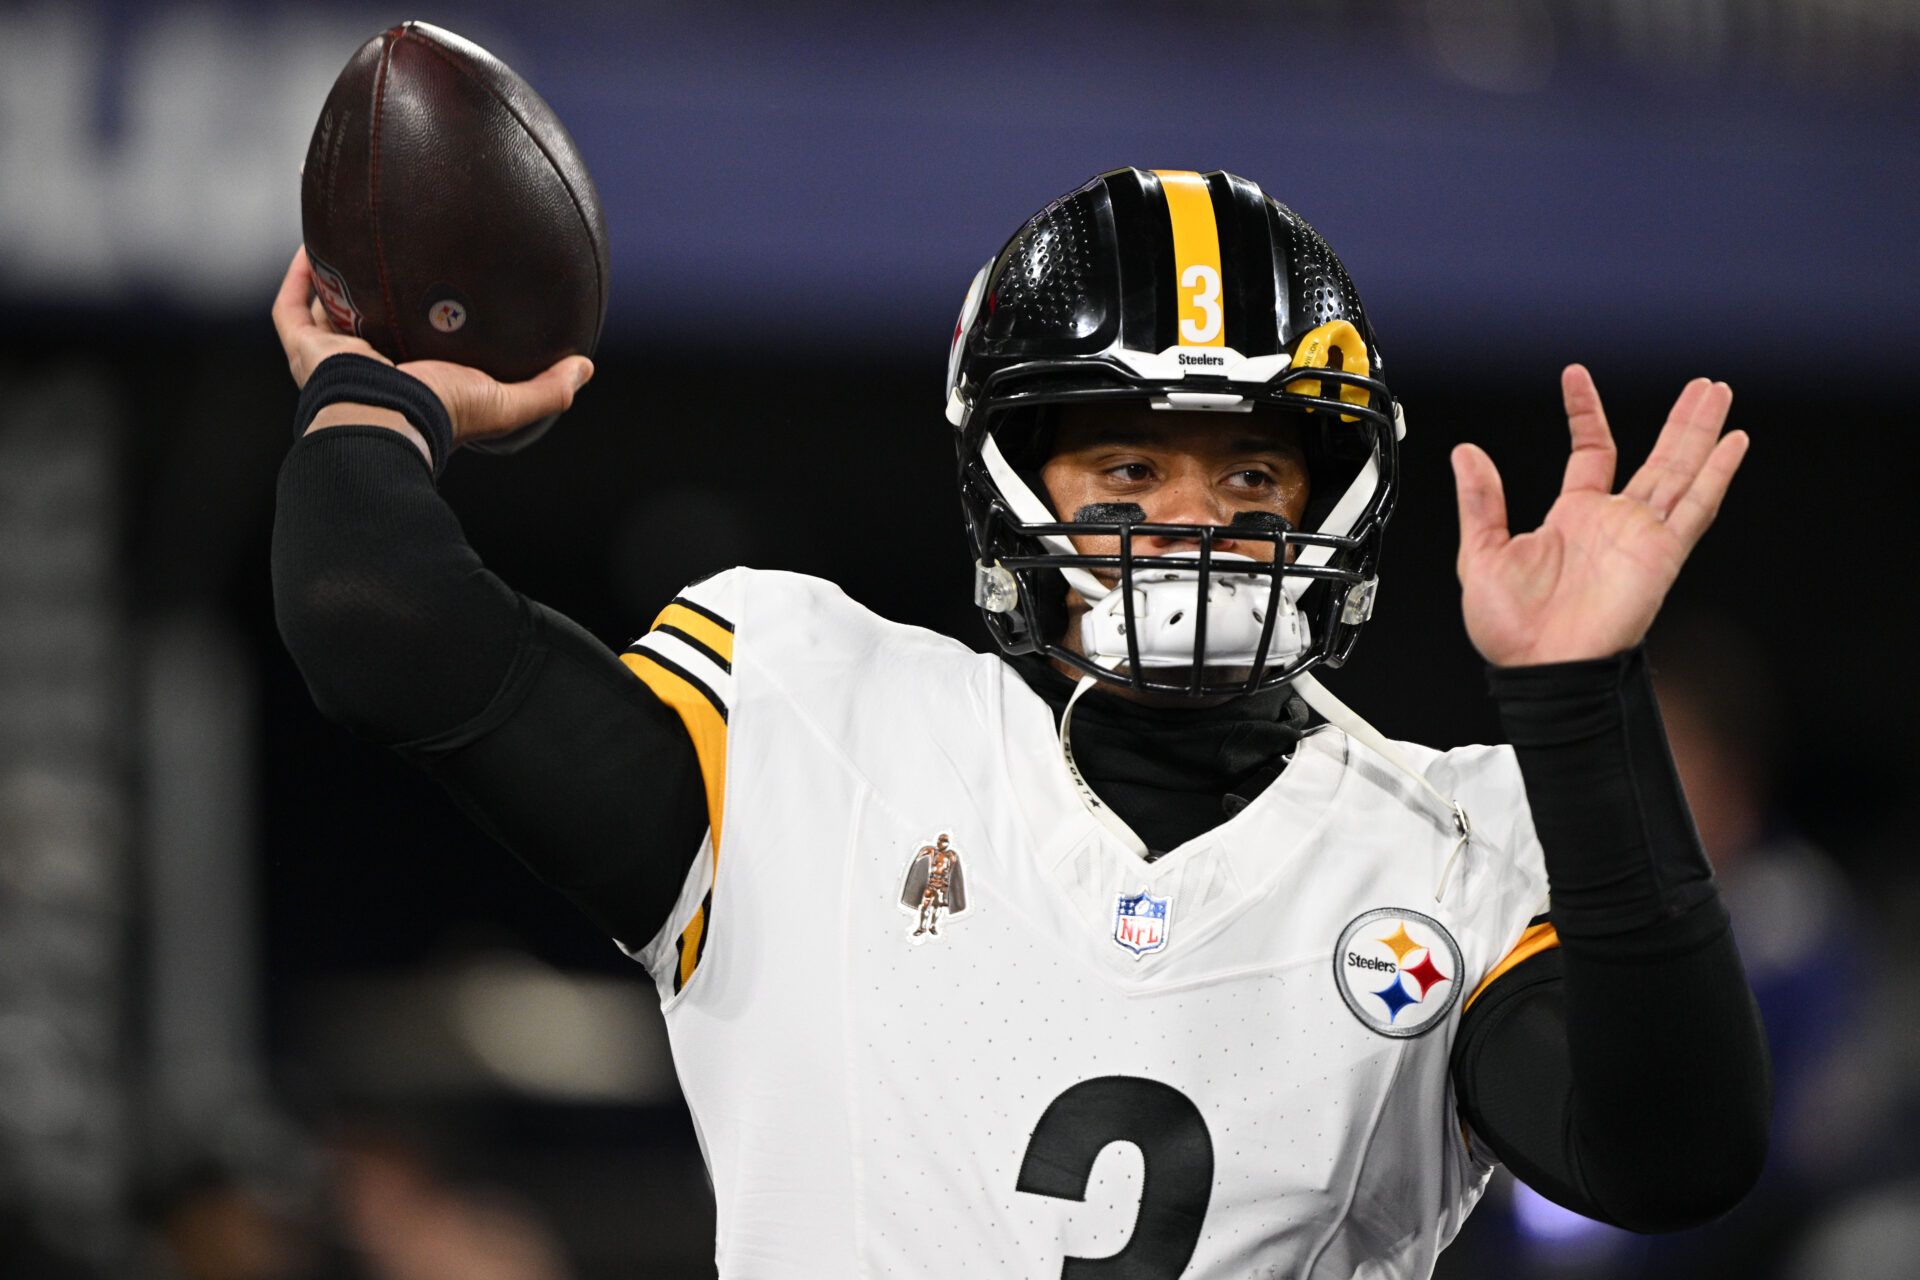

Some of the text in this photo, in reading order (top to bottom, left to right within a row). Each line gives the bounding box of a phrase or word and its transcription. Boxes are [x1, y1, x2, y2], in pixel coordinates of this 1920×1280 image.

[1181, 264, 1222, 343] 3
[1178, 353, 1224, 366] Steelers
[1120, 917, 1159, 946] NFL
[1347, 951, 1397, 974] Steelers
[1015, 1075, 1215, 1280] 3
